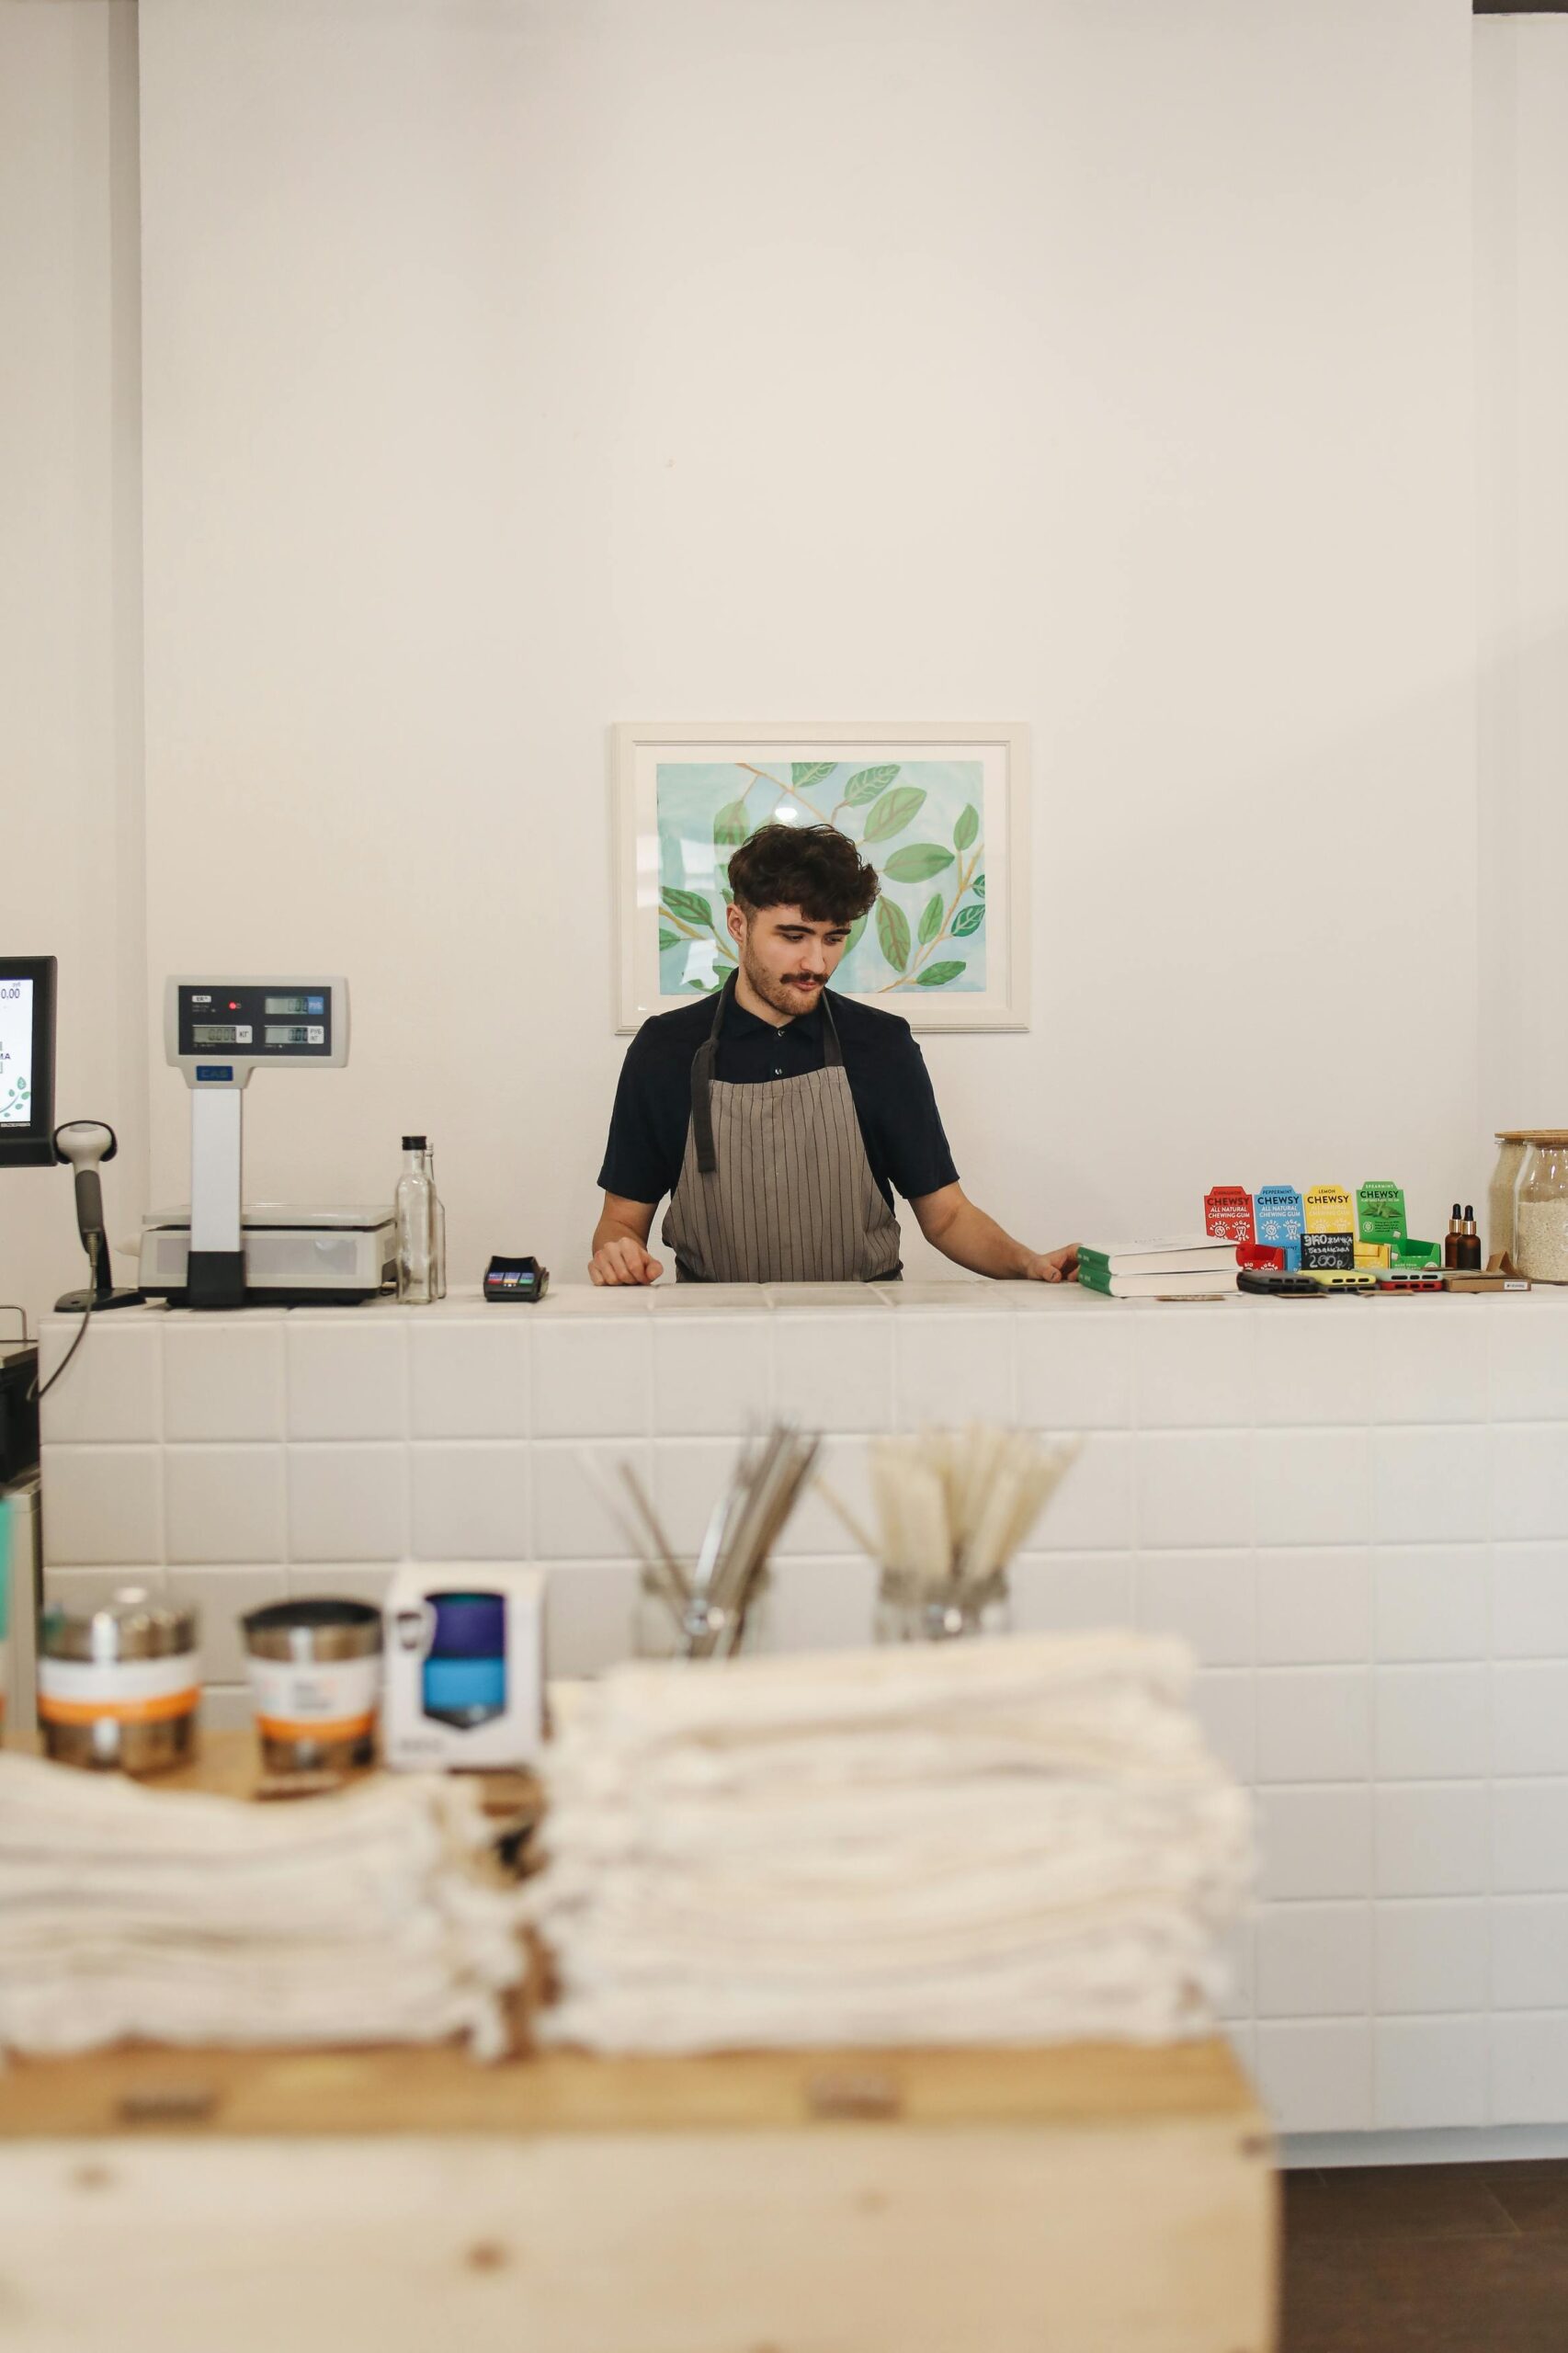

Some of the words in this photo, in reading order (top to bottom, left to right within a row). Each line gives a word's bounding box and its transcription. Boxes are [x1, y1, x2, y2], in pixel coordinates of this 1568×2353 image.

[1360, 1190, 1399, 1199] CHEWSY
[1207, 1197, 1250, 1206] CHEWSY
[1257, 1196, 1300, 1205] CHEWSY
[1307, 1195, 1349, 1204] CHEWSY
[1210, 1221, 1231, 1231] PLASTIC
[1232, 1220, 1251, 1229] SUGAR
[1261, 1219, 1282, 1230] PLASTIC
